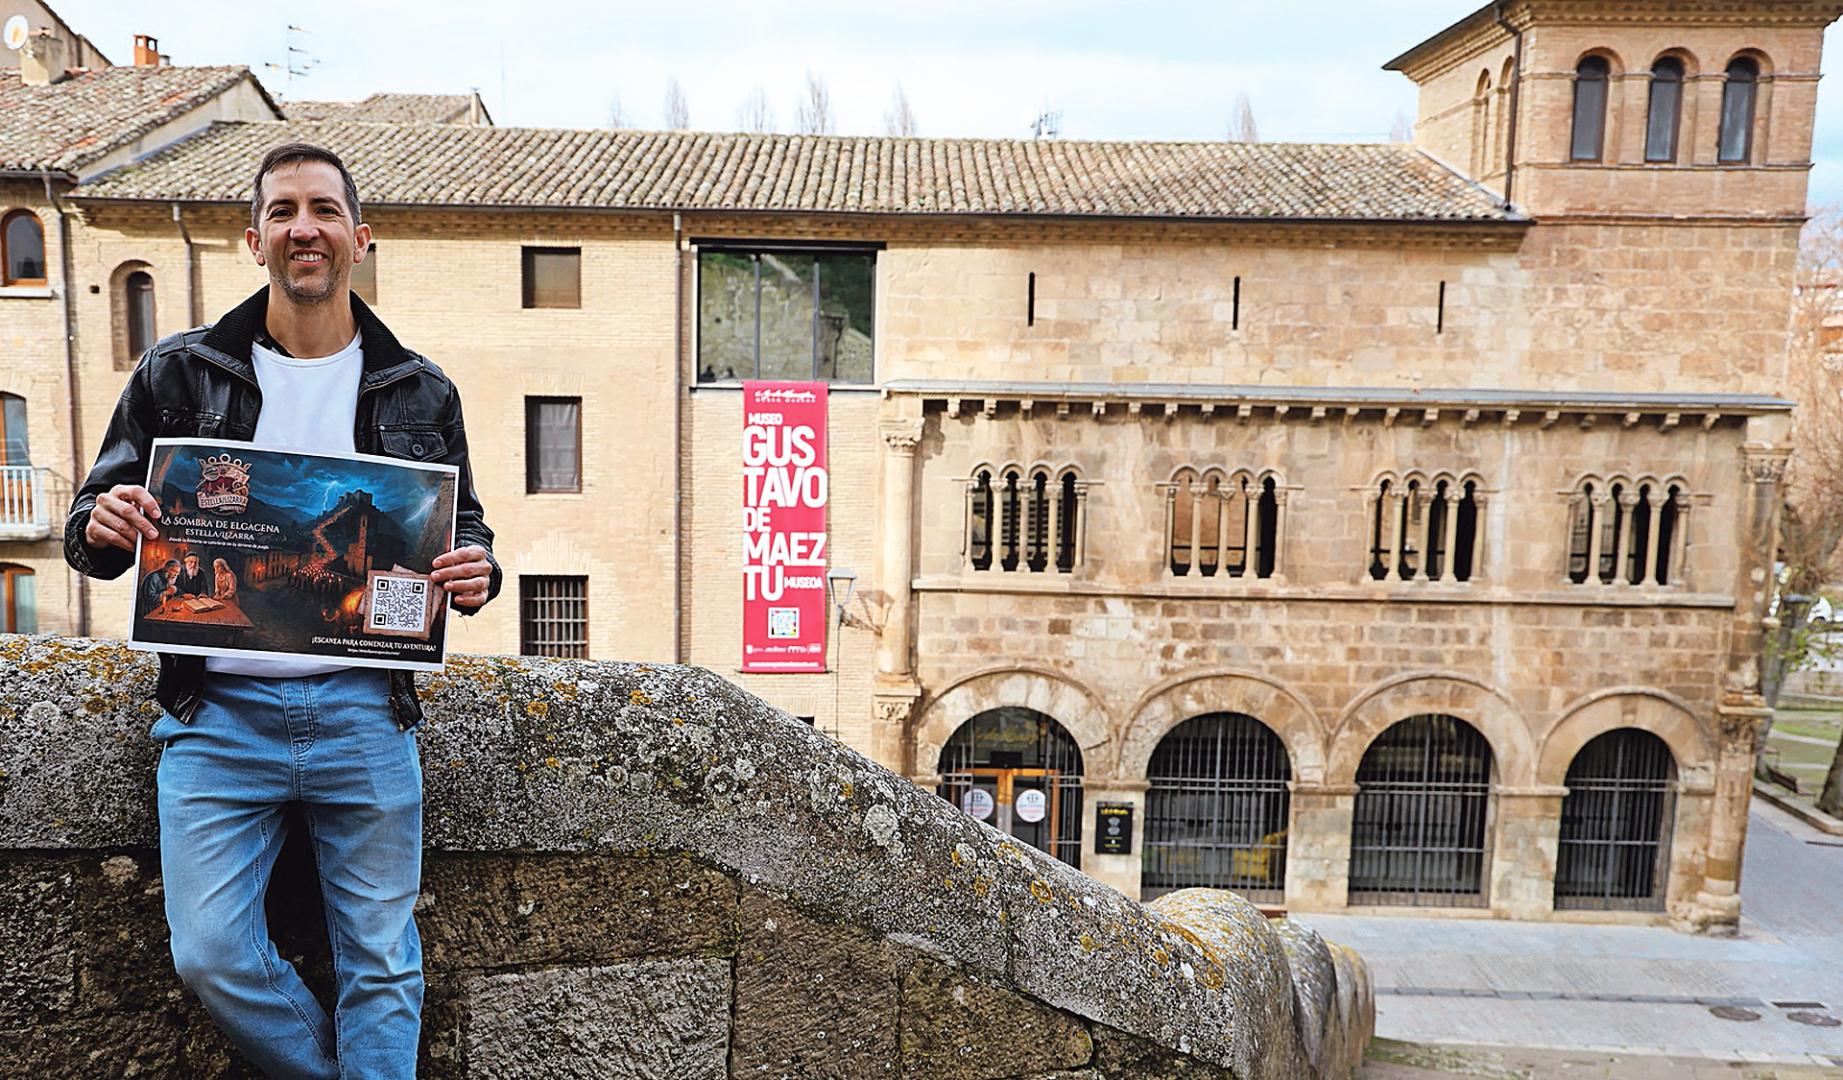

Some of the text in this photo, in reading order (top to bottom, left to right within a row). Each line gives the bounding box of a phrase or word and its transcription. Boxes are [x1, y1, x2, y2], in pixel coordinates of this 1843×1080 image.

[748, 412, 783, 425] MUSEO
[743, 425, 816, 467] GUS
[743, 466, 828, 508] TAVO
[161, 515, 172, 526] LA
[173, 516, 213, 528] SOMBRA
[215, 520, 228, 529] DE
[743, 507, 771, 532] DE
[743, 532, 827, 566] MAEZ
[743, 565, 823, 601] TU MUSEOA
[342, 638, 358, 647] PARA
[358, 639, 394, 649] COMENZAR
[402, 642, 437, 652] AVENTURA!
